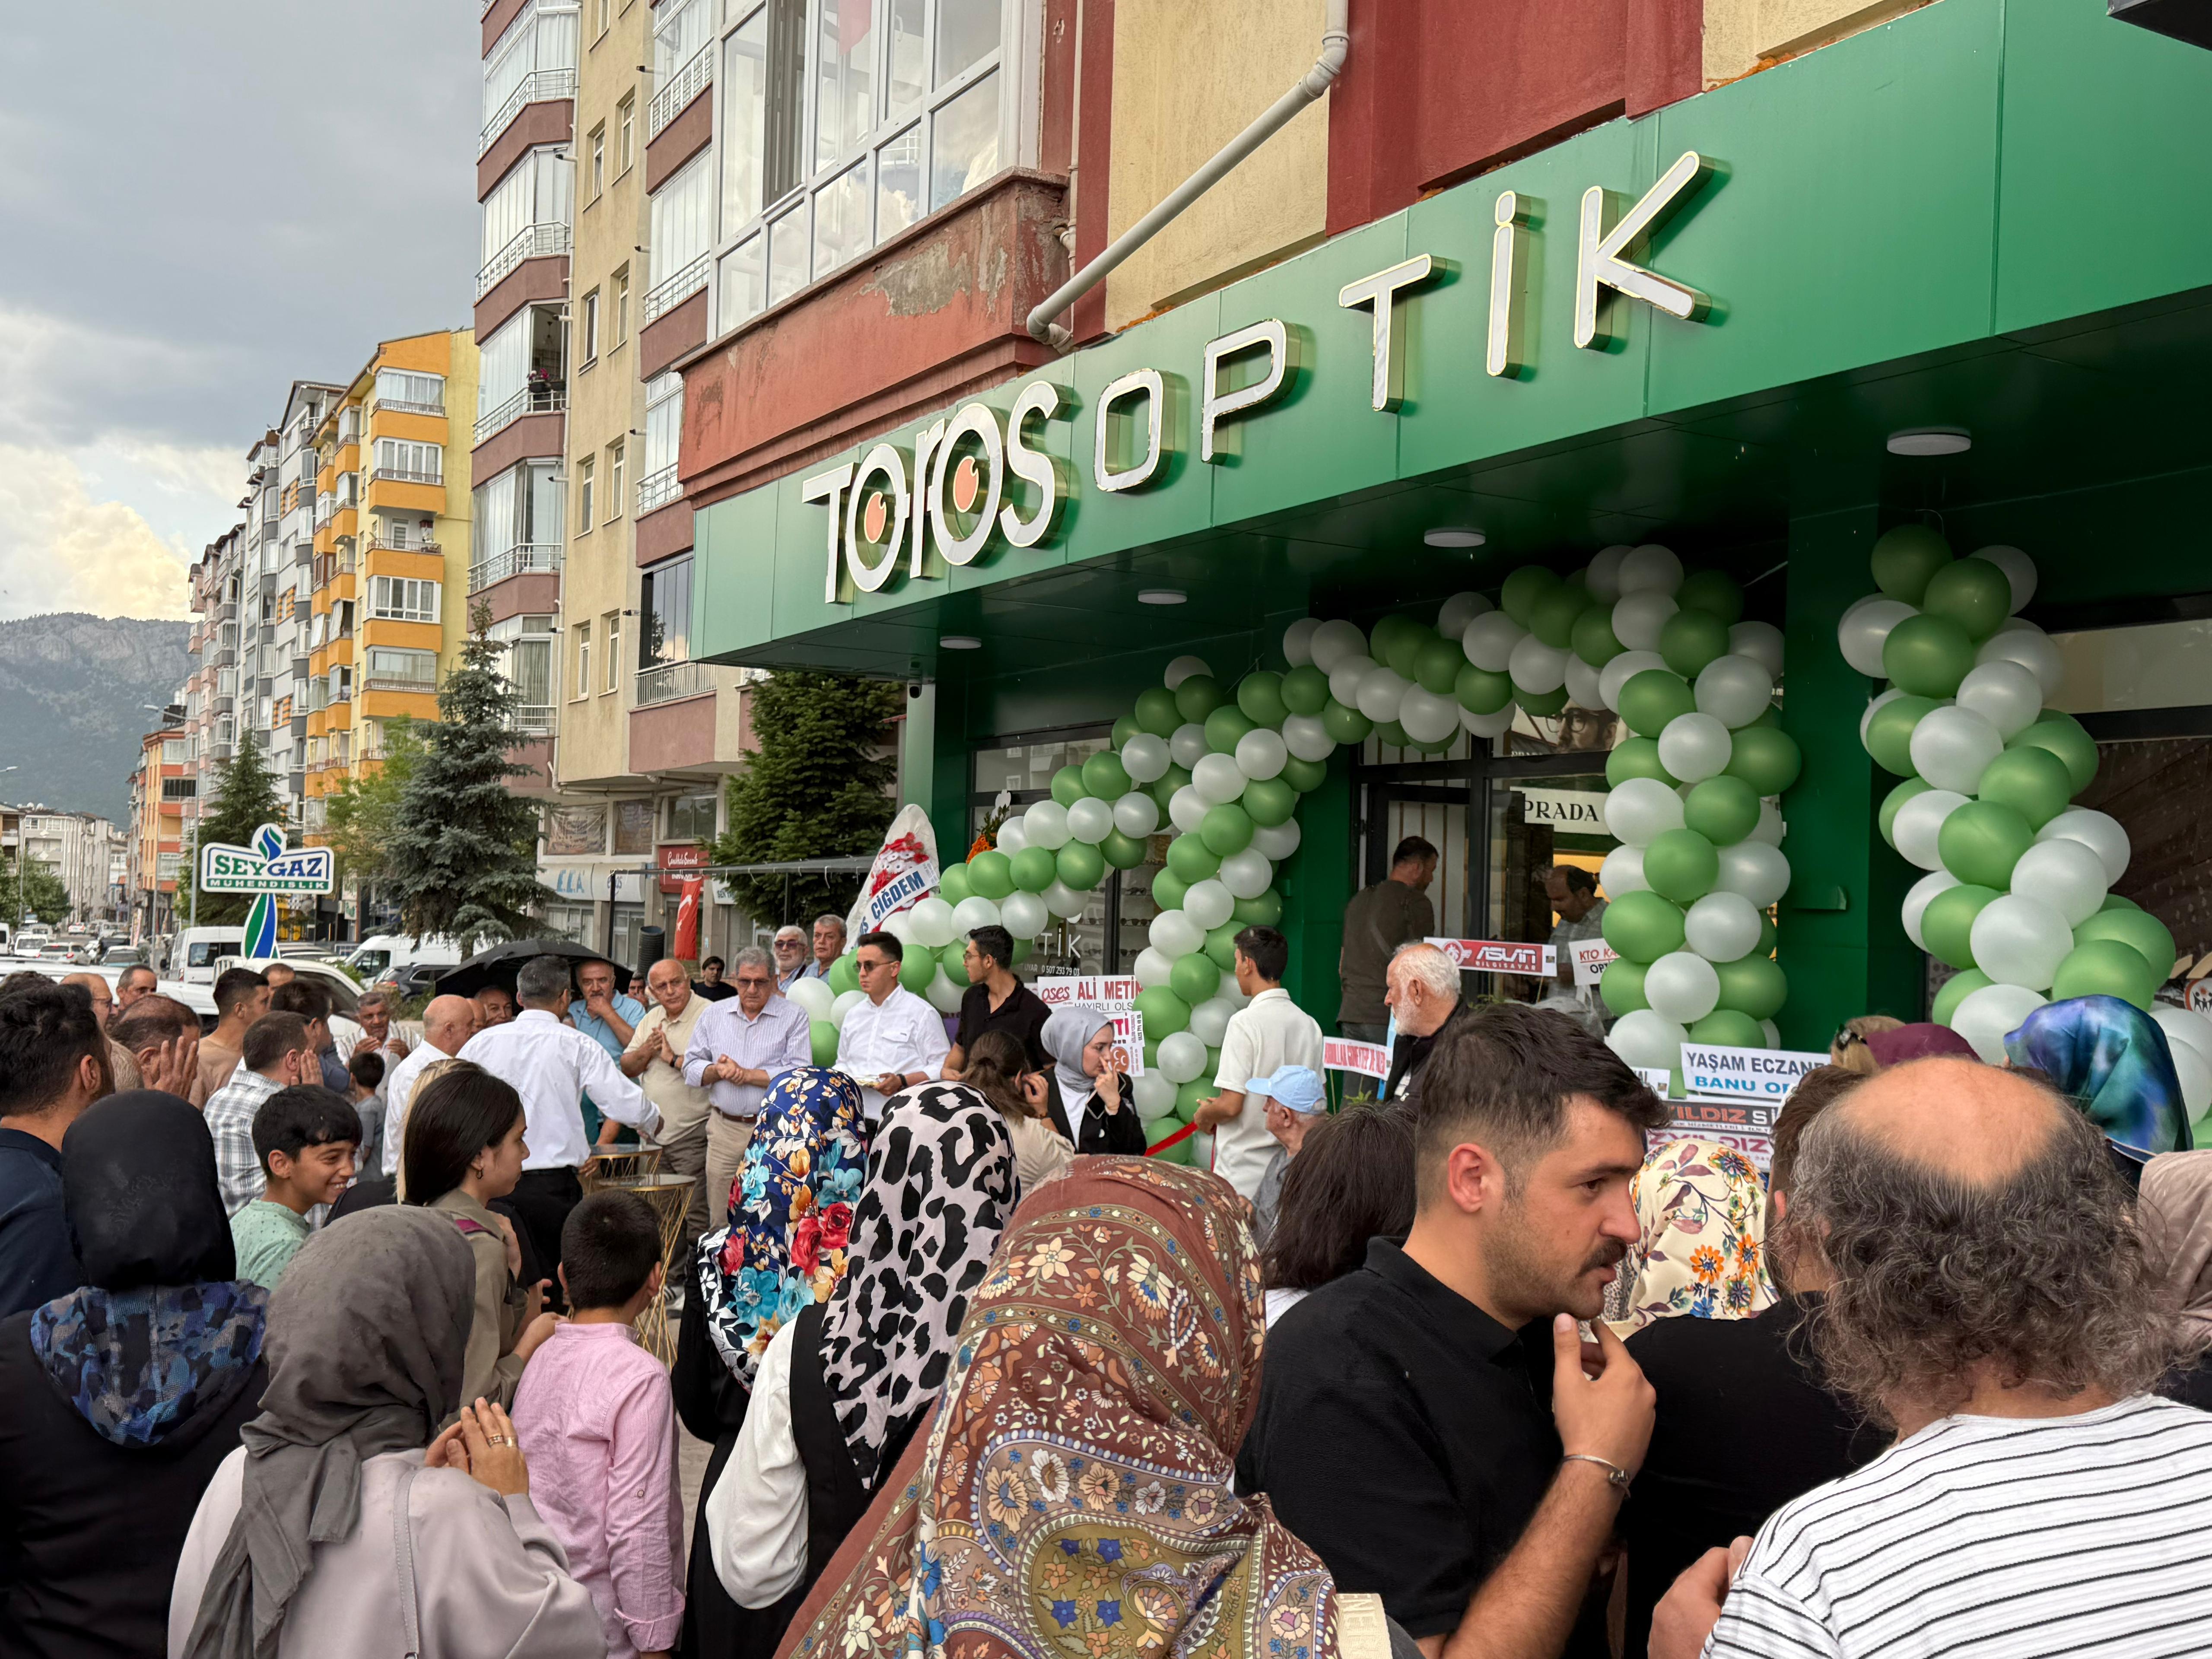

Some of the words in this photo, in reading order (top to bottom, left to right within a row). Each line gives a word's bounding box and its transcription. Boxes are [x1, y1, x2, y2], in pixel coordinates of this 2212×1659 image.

[1093, 150, 1700, 493] OPTİK
[215, 854, 323, 877] SEYGAZ
[210, 878, 324, 890] MÜHENDİSLİK
[871, 871, 925, 922] ÇİĞDEM
[1032, 928, 1081, 958] TİK
[1579, 949, 1599, 960] KTO
[1041, 964, 1046, 973] 0
[1055, 966, 1065, 975] 293
[1065, 967, 1072, 976] 79
[1073, 967, 1080, 976] 03
[1077, 977, 1097, 1000] ALİ
[1687, 1051, 1745, 1073] YAŞAM
[1695, 1076, 1755, 1092] BANU
[1671, 1106, 1747, 1123] ILDIZ
